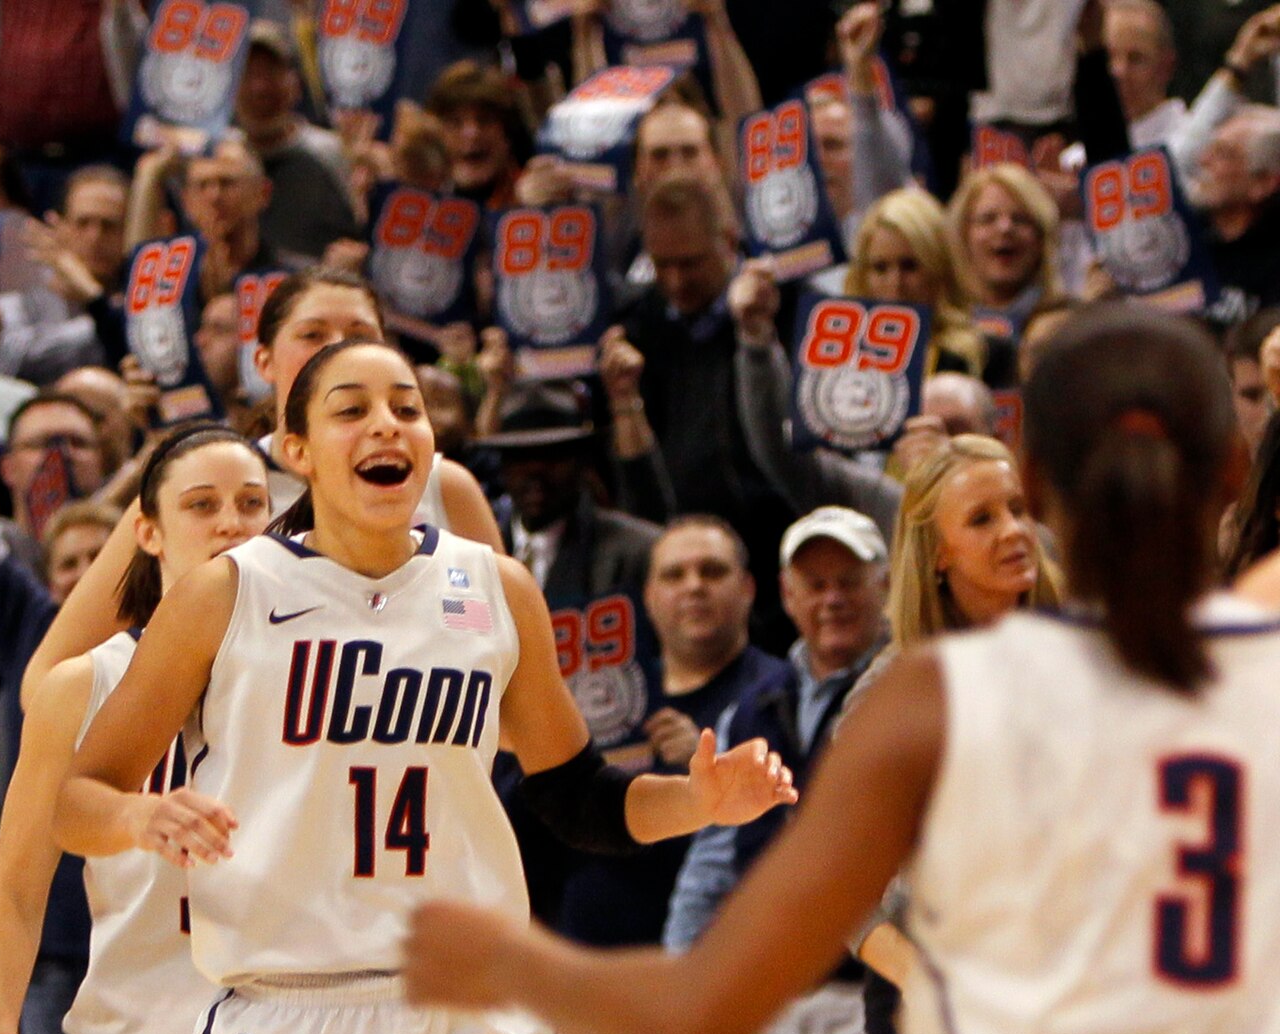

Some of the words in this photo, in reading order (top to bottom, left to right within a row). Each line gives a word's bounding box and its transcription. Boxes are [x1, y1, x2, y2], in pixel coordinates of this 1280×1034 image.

[148, 0, 249, 62] 89
[744, 100, 807, 184] 89
[376, 189, 479, 258] 89
[1084, 153, 1173, 232] 89
[127, 236, 196, 312] 89
[497, 207, 596, 277] 89
[805, 299, 919, 375] 89
[282, 640, 491, 748] UConn
[348, 767, 430, 877] 14
[1154, 752, 1244, 991] 3
